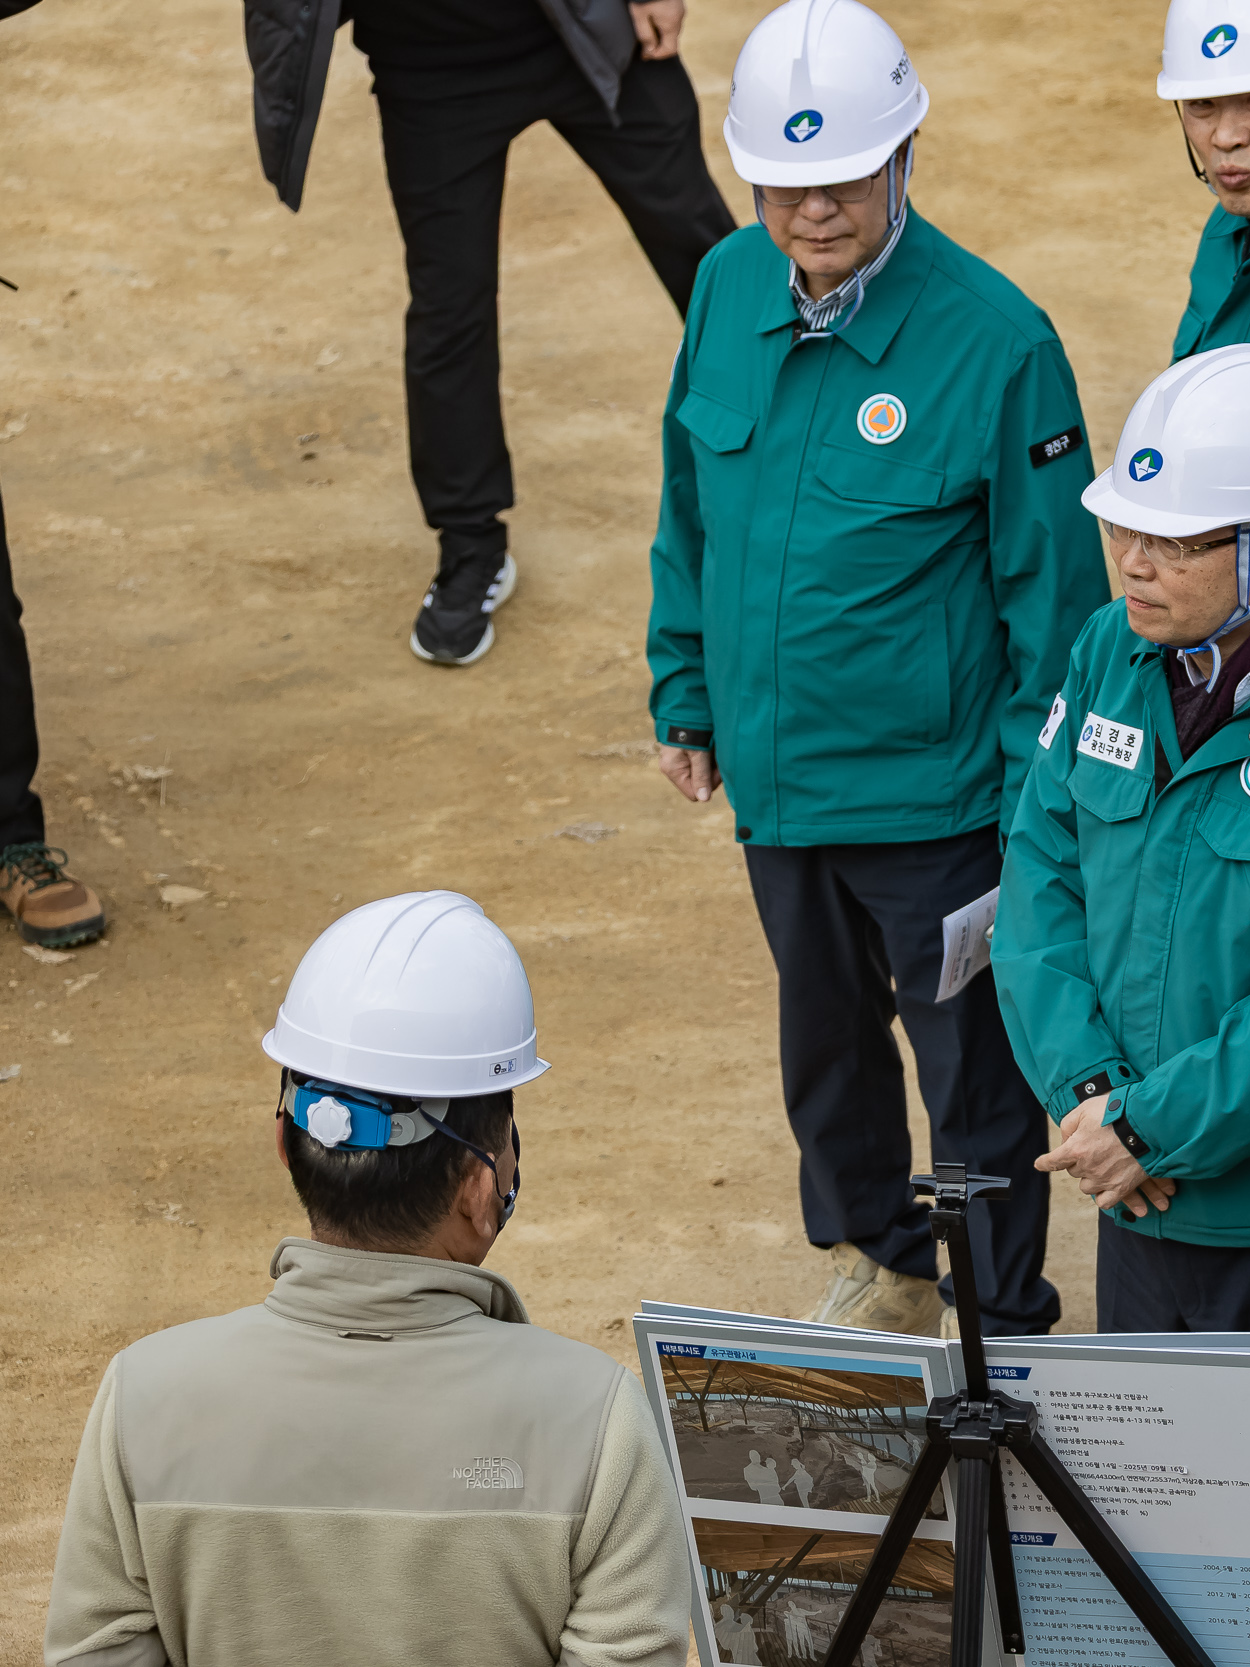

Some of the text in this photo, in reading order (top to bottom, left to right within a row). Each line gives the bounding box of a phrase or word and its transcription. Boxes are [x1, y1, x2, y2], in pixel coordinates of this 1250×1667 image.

[1044, 435, 1070, 457] 광진구
[1091, 739, 1132, 762] 광진구청장
[662, 1344, 757, 1360] 내부투시도 유구관람시설
[473, 1456, 500, 1467] THE
[1085, 1461, 1100, 1469] 06월
[452, 1467, 500, 1479] NORTH
[466, 1478, 501, 1489] FACE
[1011, 1534, 1044, 1543] 추진개요
